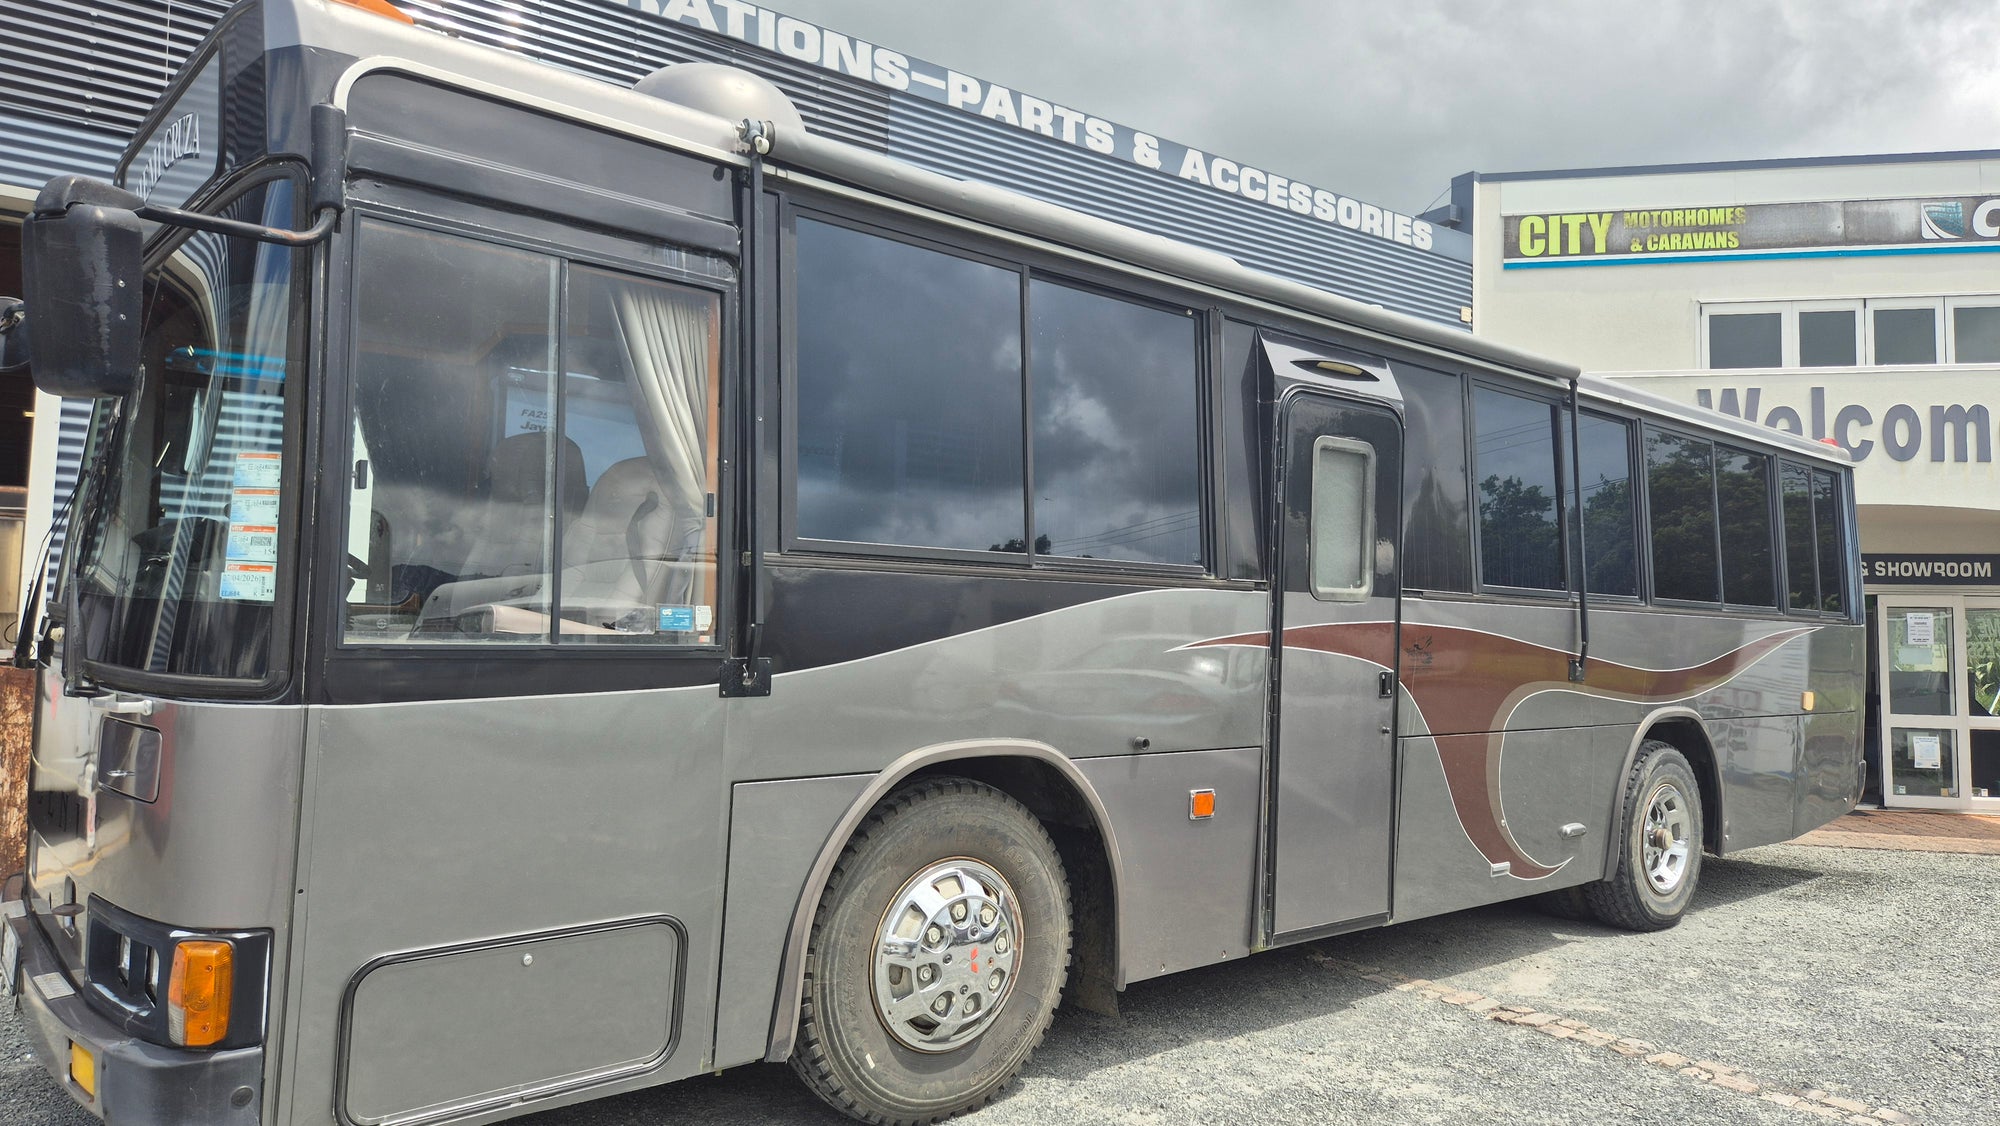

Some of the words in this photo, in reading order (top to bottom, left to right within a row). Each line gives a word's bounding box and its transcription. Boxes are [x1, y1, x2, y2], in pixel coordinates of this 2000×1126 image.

[163, 112, 200, 168] CRUZA
[1133, 132, 1162, 170] &
[1179, 148, 1433, 250] ACCESSORIES
[1624, 207, 1747, 229] MOTORHOMES
[1519, 213, 1613, 257] CITY
[1630, 237, 1643, 252] &
[1646, 231, 1739, 251] CARAVANS
[1875, 561, 1992, 577] SHOWROOM
